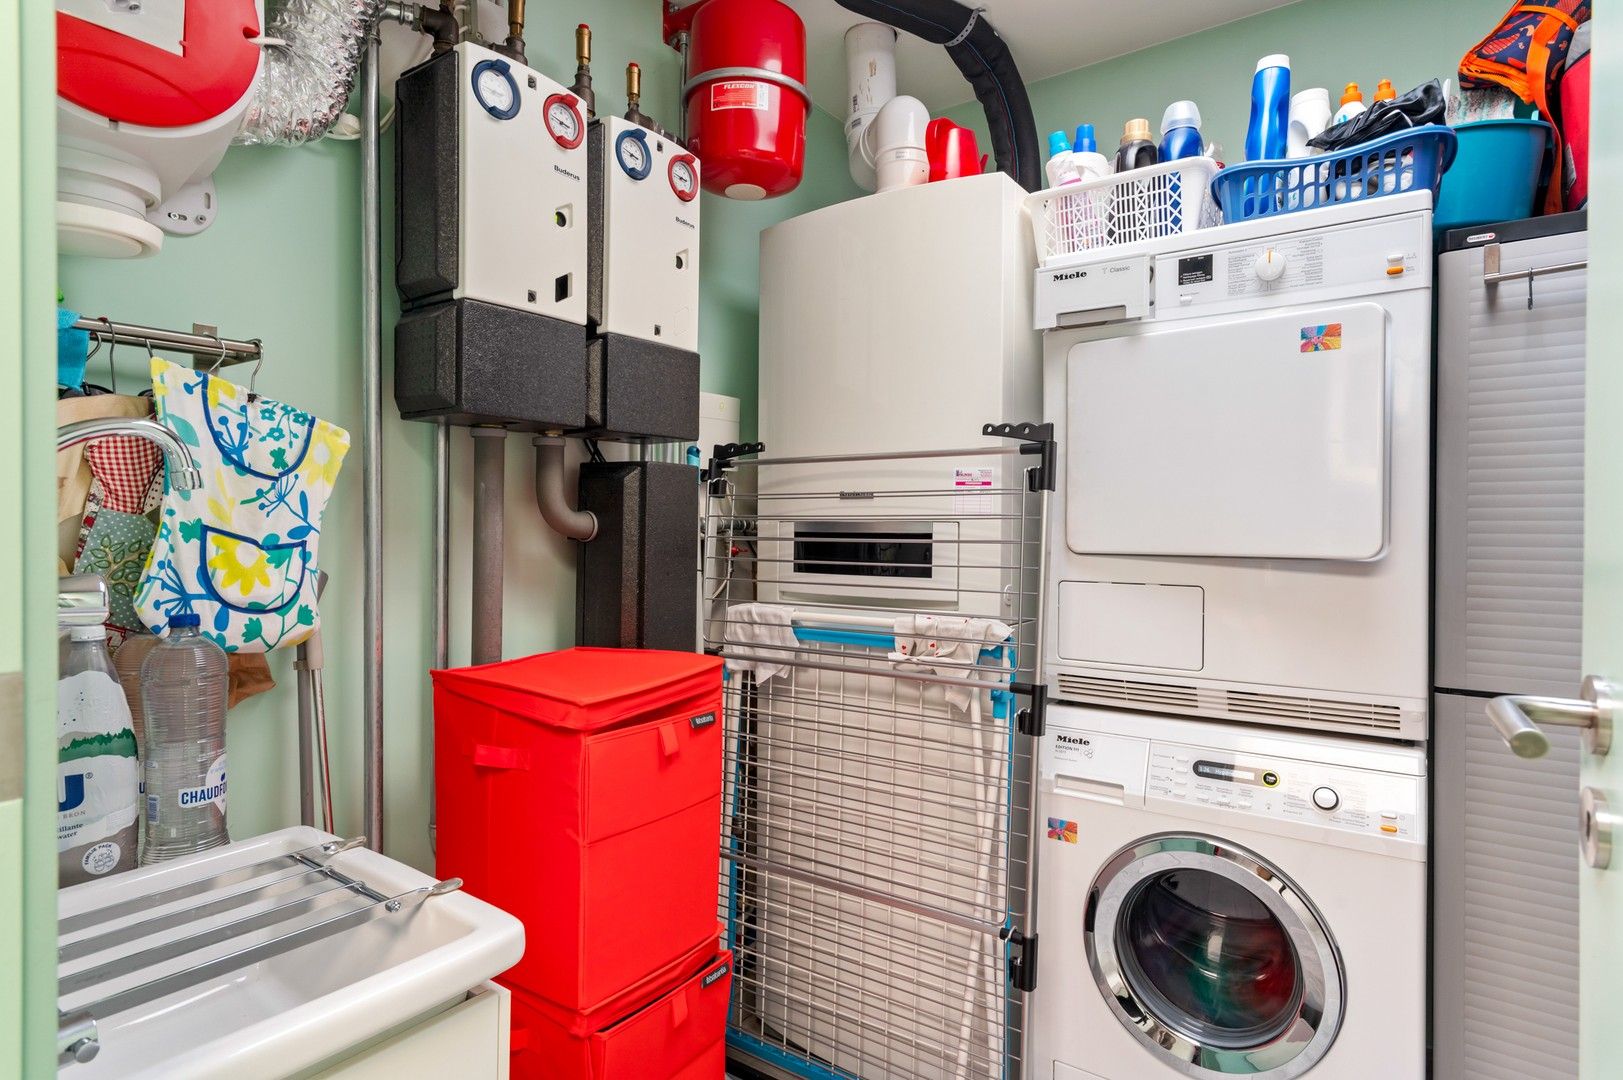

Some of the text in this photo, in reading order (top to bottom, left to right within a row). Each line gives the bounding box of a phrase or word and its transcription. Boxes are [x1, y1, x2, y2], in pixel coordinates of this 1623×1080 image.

[553, 164, 580, 181] Buderus
[1053, 271, 1087, 281] Miele
[1056, 734, 1091, 746] Miele
